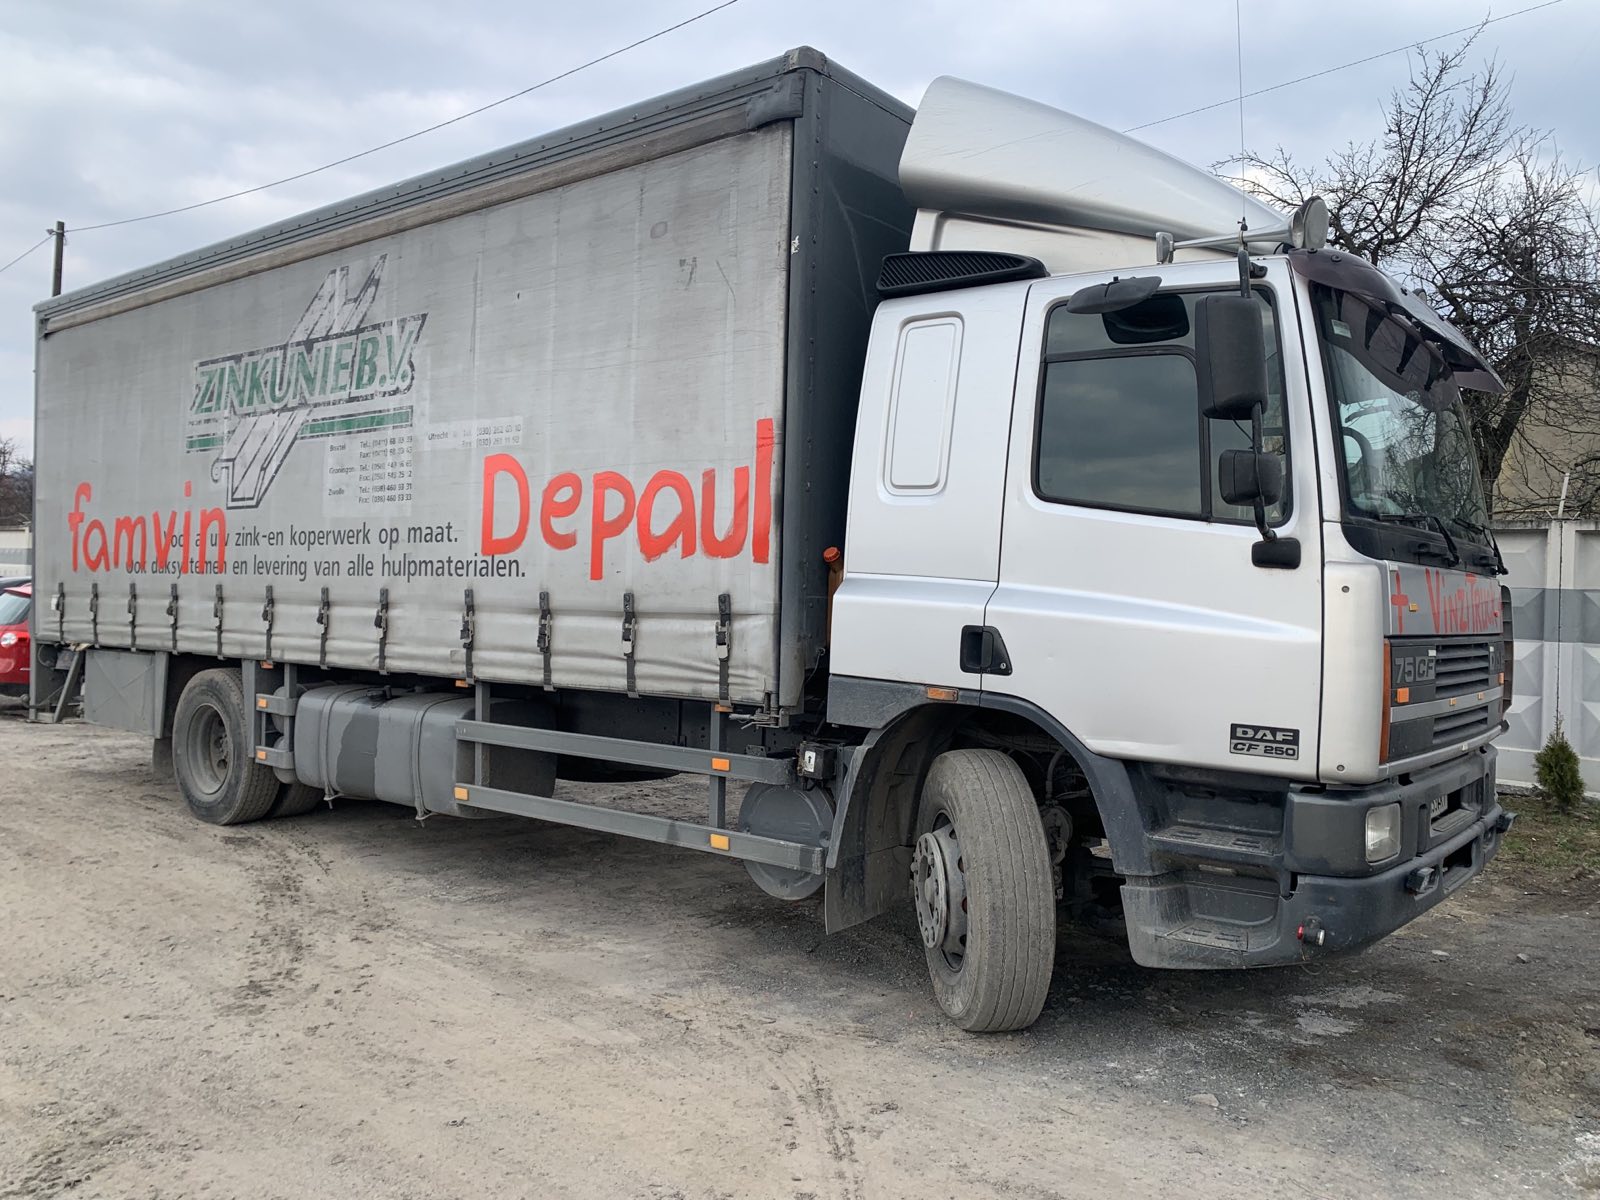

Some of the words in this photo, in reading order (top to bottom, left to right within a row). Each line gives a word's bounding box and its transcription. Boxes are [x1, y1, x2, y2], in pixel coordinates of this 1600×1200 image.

[481, 418, 774, 580] Depaul
[68, 480, 227, 575] famvin
[235, 525, 284, 547] zink-en
[290, 521, 371, 551] koperwerk
[378, 527, 400, 550] op
[407, 522, 458, 544] maat.
[232, 559, 248, 575] en
[253, 554, 307, 582] levering
[314, 560, 340, 577] van
[347, 553, 374, 577] alle
[381, 552, 526, 583] hulpmaterialen.
[1232, 742, 1260, 753] CF
[1263, 745, 1297, 757] 250
[1236, 727, 1294, 742] DAF
